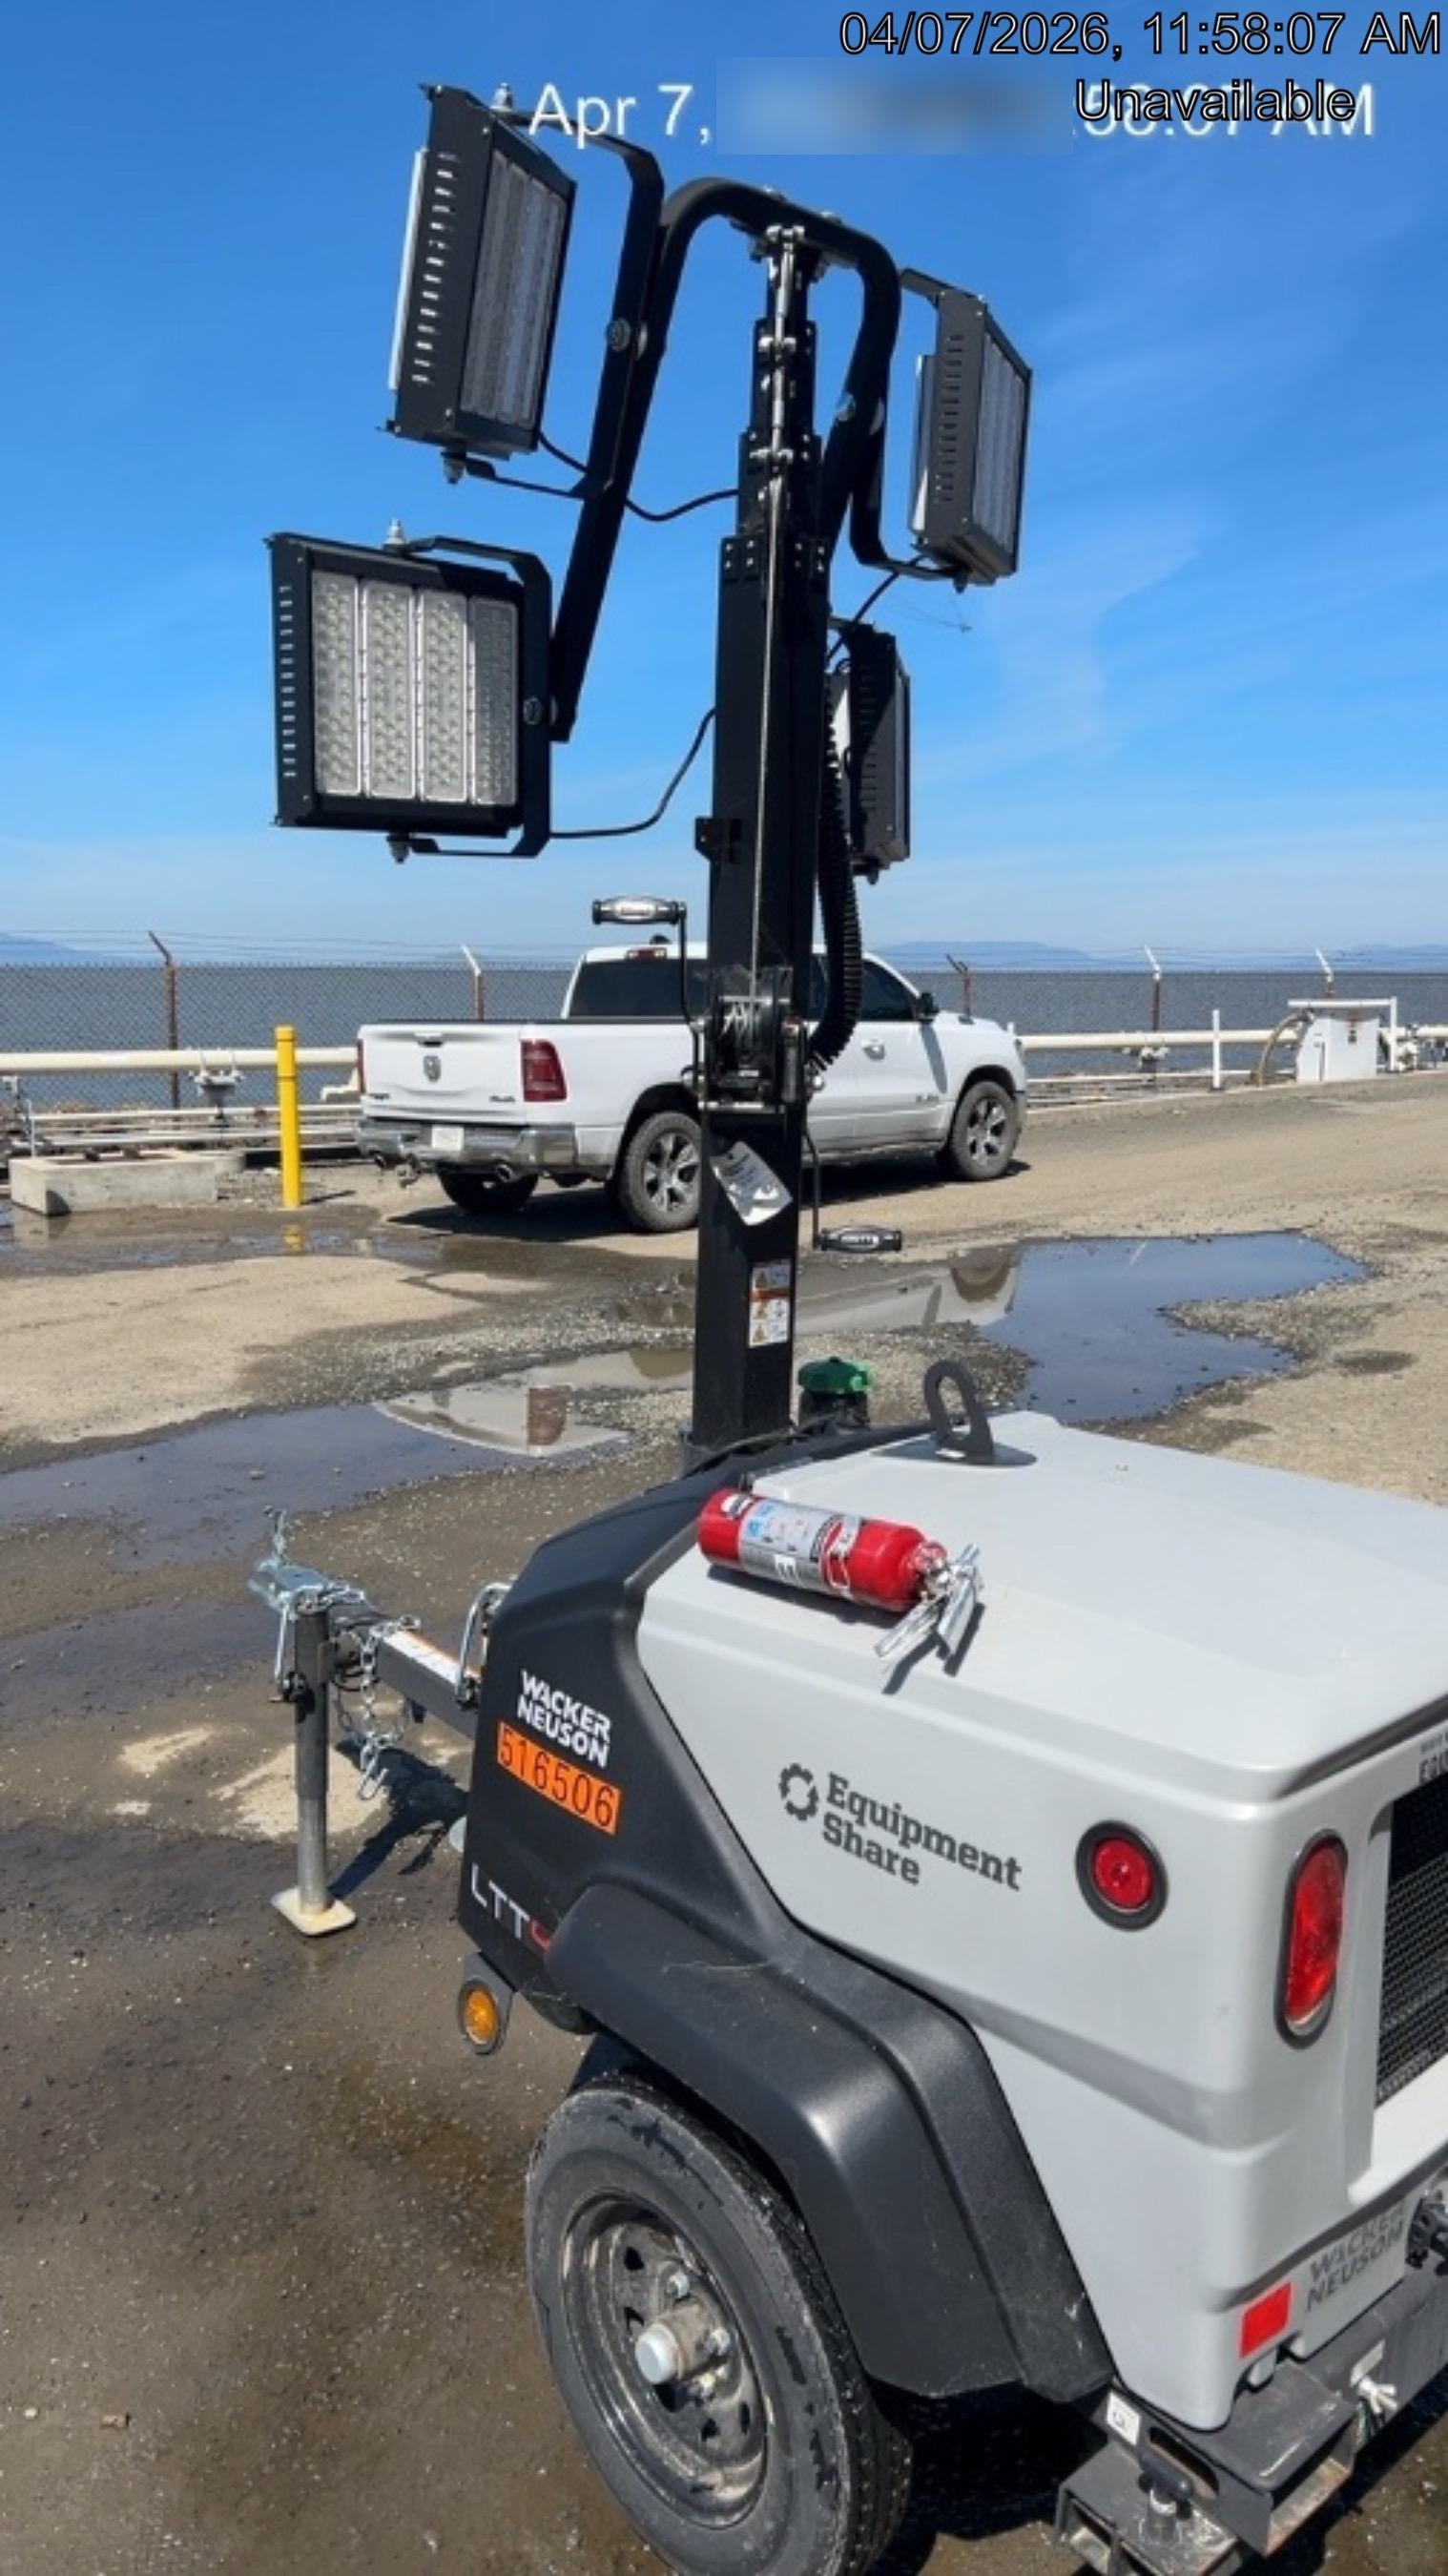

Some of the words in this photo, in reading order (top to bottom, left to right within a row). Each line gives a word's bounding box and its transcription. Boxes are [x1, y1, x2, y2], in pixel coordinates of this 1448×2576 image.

[517, 1694, 610, 1769] NEUSON
[520, 1668, 611, 1743] WACKER
[500, 1726, 614, 1827] 516506
[822, 1811, 921, 1886] Share
[826, 1771, 1024, 1892] Equipment
[1305, 2219, 1404, 2314] NEUSON
[1310, 2203, 1405, 2283] WACKER
